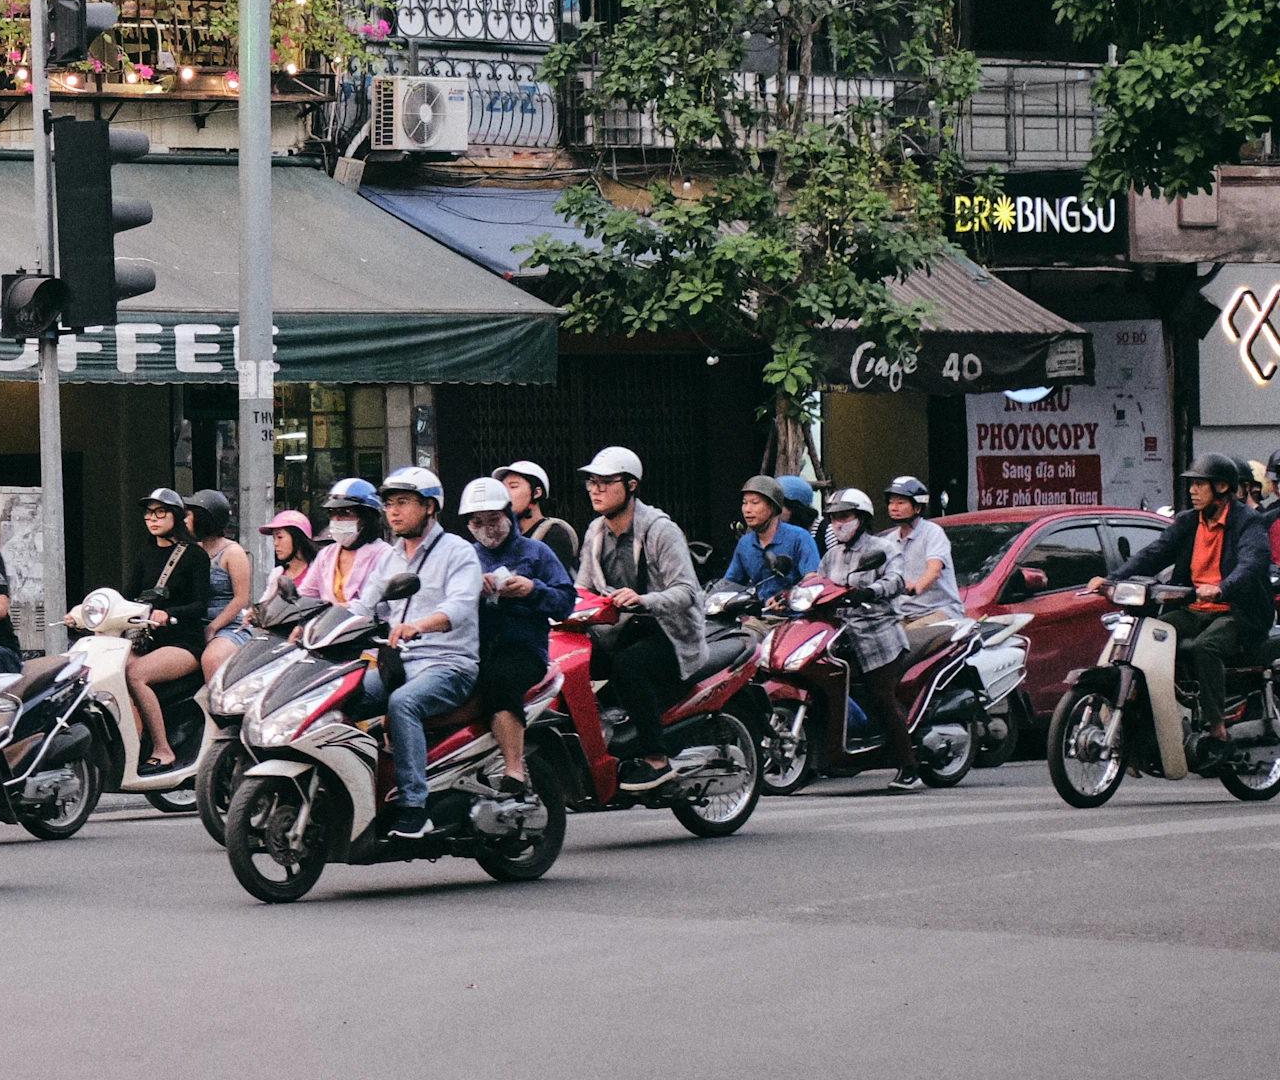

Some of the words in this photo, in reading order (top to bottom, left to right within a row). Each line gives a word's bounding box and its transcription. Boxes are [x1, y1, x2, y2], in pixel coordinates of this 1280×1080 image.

[941, 351, 983, 382] 40
[975, 422, 1100, 451] PHOTOCOPY
[1001, 460, 1032, 483] Sang
[995, 488, 1009, 507] 2F
[1033, 487, 1067, 506] Quang
[1068, 487, 1099, 506] Trung
